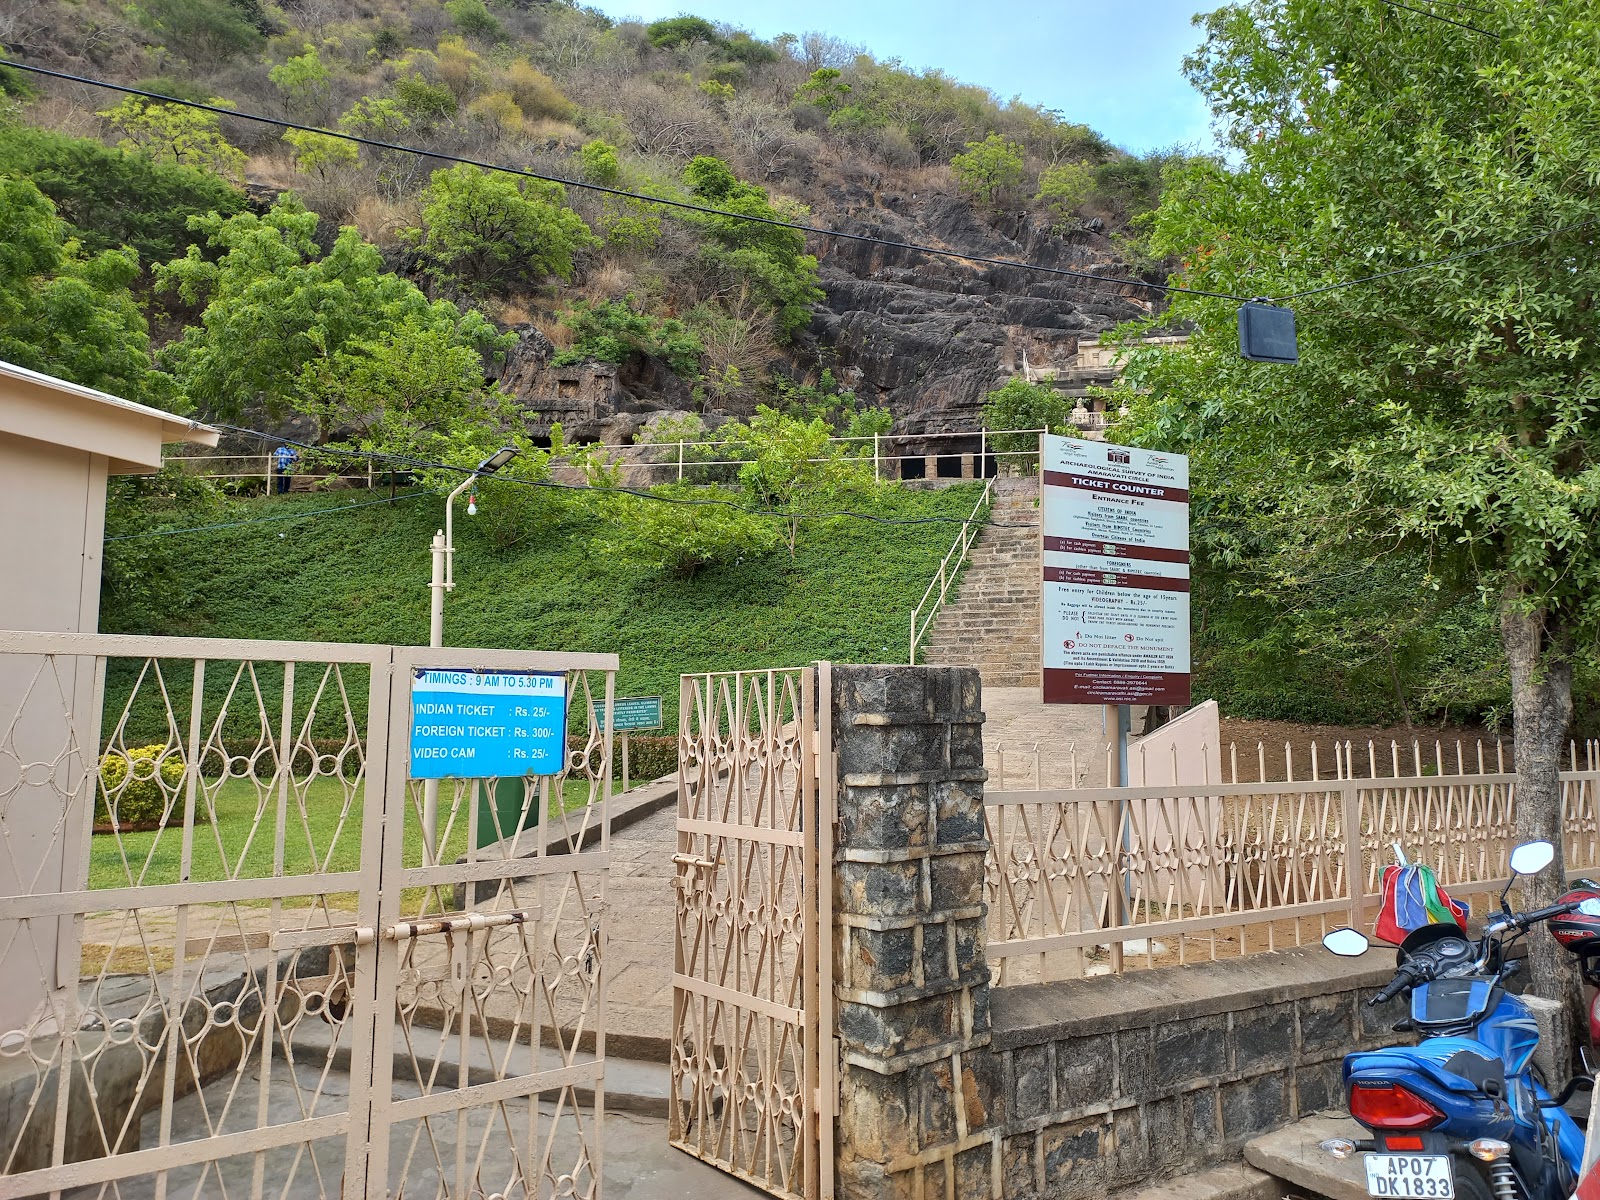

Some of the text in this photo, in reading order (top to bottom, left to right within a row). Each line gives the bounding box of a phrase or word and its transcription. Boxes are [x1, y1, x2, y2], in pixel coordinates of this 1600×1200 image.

[1060, 461, 1120, 473] ARCHAEOLOGICAL
[1088, 470, 1127, 479] AMARAVATI
[1071, 477, 1164, 496] TICKET COUNTER
[424, 672, 467, 685] TIMINGS
[475, 676, 481, 686] 9
[484, 676, 499, 687] AM
[503, 677, 515, 687] TO
[518, 677, 536, 688] 5.30
[539, 678, 553, 688] PM
[416, 704, 453, 714] INDIAN
[456, 705, 495, 716] TICKET
[515, 707, 530, 716] Rs.
[533, 707, 550, 717] 25/-
[415, 726, 464, 736] FOREIGN
[468, 727, 505, 737] TICKET
[514, 729, 529, 737] Rs.
[532, 728, 554, 738] 300/-
[414, 748, 448, 758] VIDEO
[451, 748, 475, 758] CAM
[514, 748, 529, 758] Rs.
[532, 749, 548, 759] 25/-
[1388, 1157, 1435, 1176] AP07
[1376, 1176, 1449, 1196] DK1833
